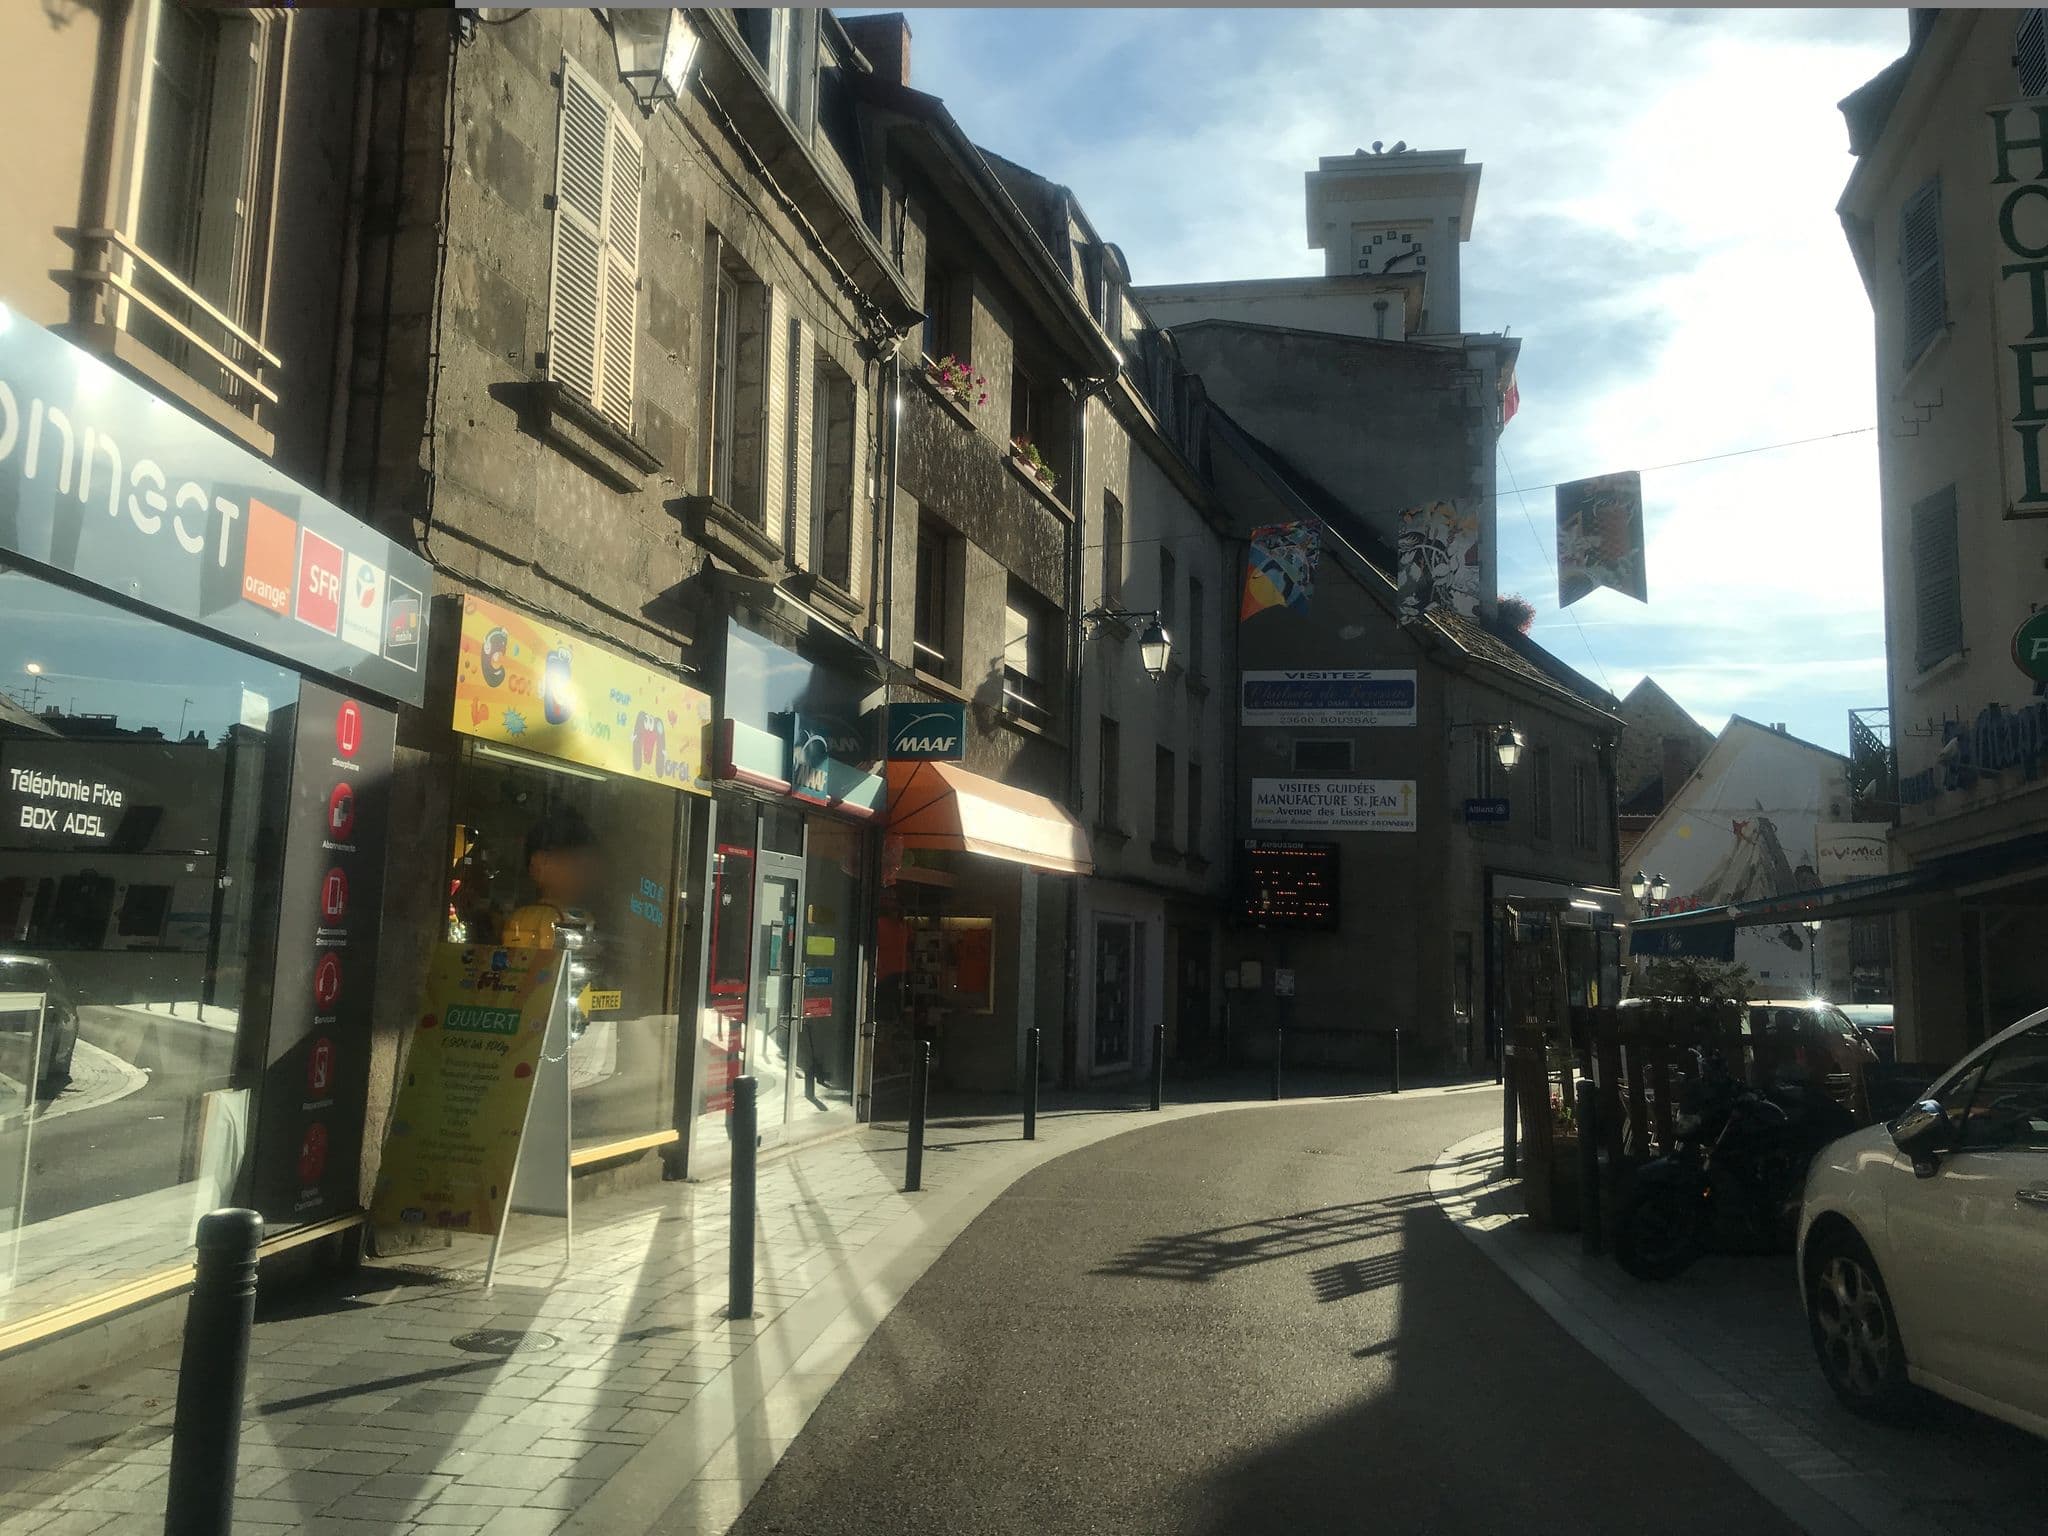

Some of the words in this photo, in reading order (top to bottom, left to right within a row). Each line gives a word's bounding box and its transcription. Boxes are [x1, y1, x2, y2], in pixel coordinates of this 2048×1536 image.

[1986, 105, 2048, 502] HOTEL
[246, 575, 288, 608] orange
[309, 564, 340, 604] SFR
[1284, 671, 1372, 680] VISITEZ
[895, 737, 958, 752] MAAF
[10, 767, 90, 802] Téléphonie
[92, 783, 122, 808] Fixe
[1278, 783, 1321, 793] VISITES
[1326, 781, 1376, 793] GUIDÉES
[1257, 794, 1348, 806] MANUFACTURE
[20, 805, 58, 831] BOX
[62, 812, 106, 838] ADSL
[1276, 806, 1312, 816] Avenue
[1317, 807, 1335, 816] des
[1341, 807, 1377, 817] Lissiers
[447, 1009, 520, 1031] OUVERT
